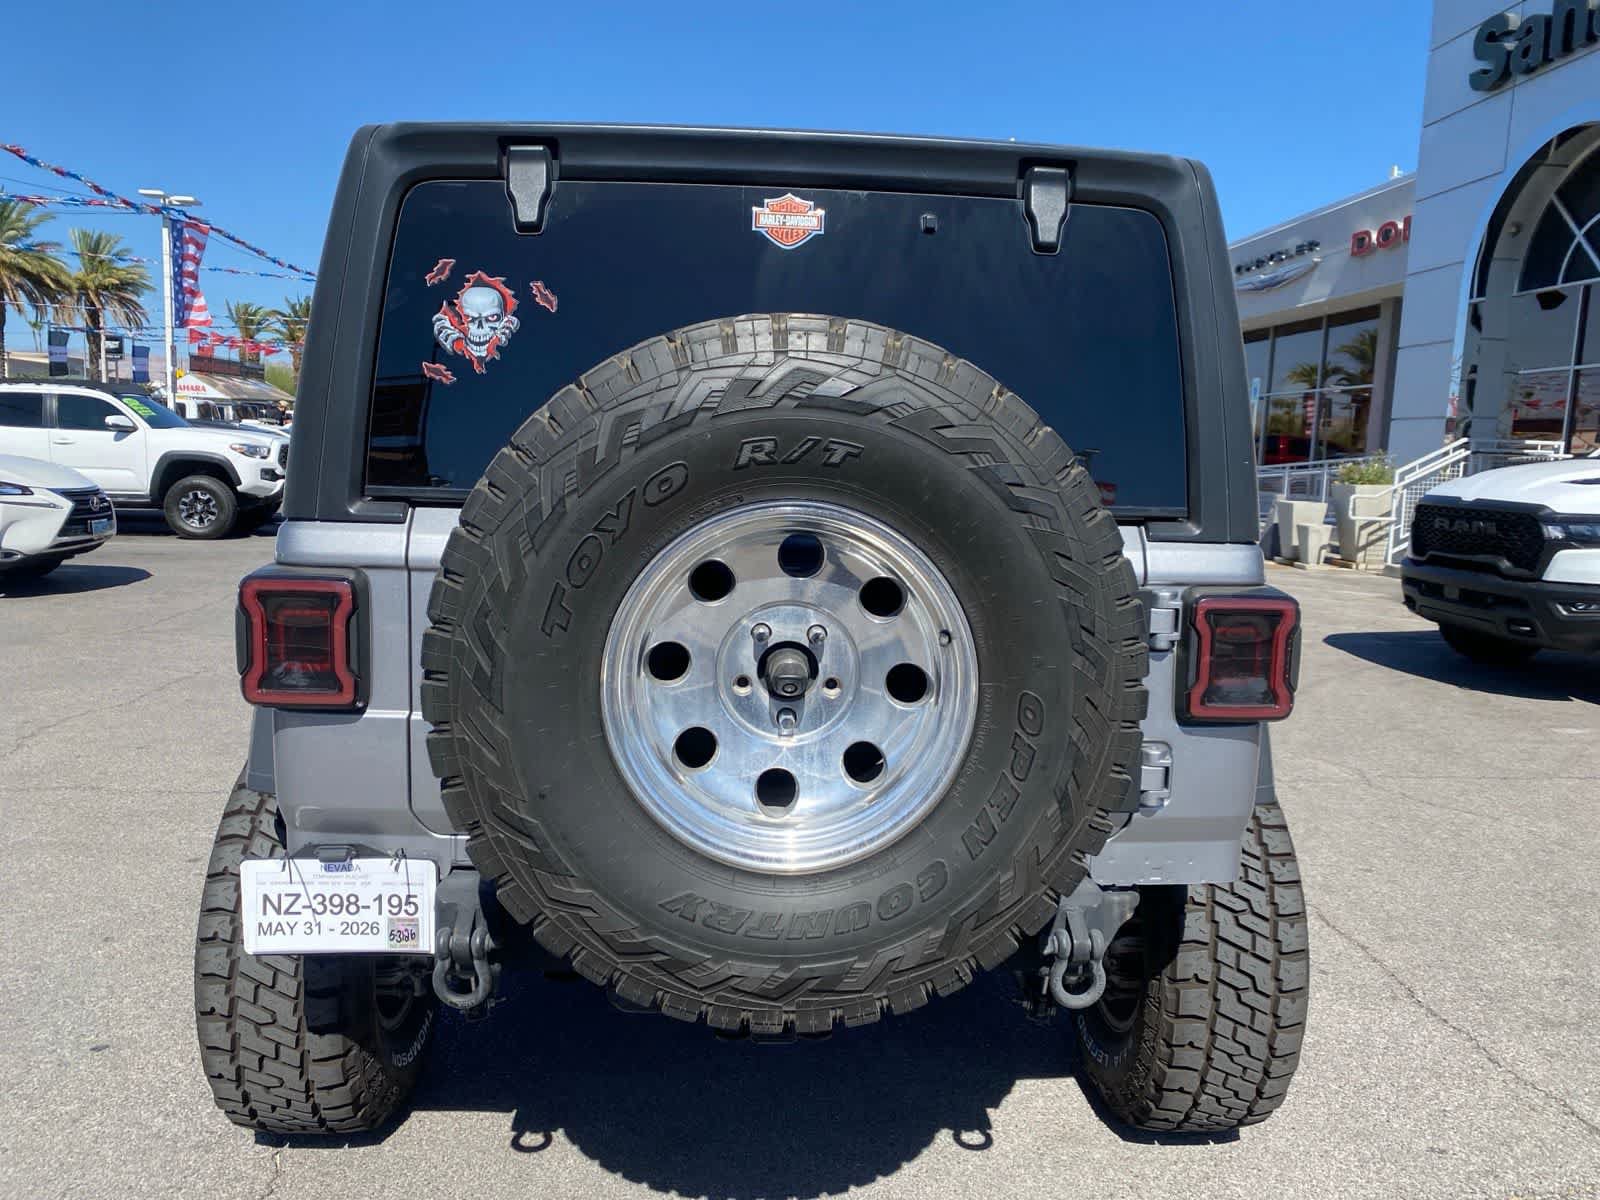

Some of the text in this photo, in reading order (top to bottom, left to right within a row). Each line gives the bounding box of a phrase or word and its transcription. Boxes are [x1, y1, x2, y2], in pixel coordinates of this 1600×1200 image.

[1469, 0, 1600, 92] Sah
[771, 203, 807, 213] MOTOR
[760, 214, 817, 227] HARLEY-DAVIDSON
[771, 229, 804, 242] CYCLES
[735, 436, 865, 469] R/T
[541, 461, 689, 638] TOYO
[960, 690, 1045, 861] OPEN
[320, 864, 361, 873] NEVADA
[262, 893, 419, 916] NZ-398-195
[658, 858, 950, 941] COUNTRY
[258, 922, 299, 936] MAY
[304, 922, 322, 935] 31
[340, 921, 380, 935] 2026
